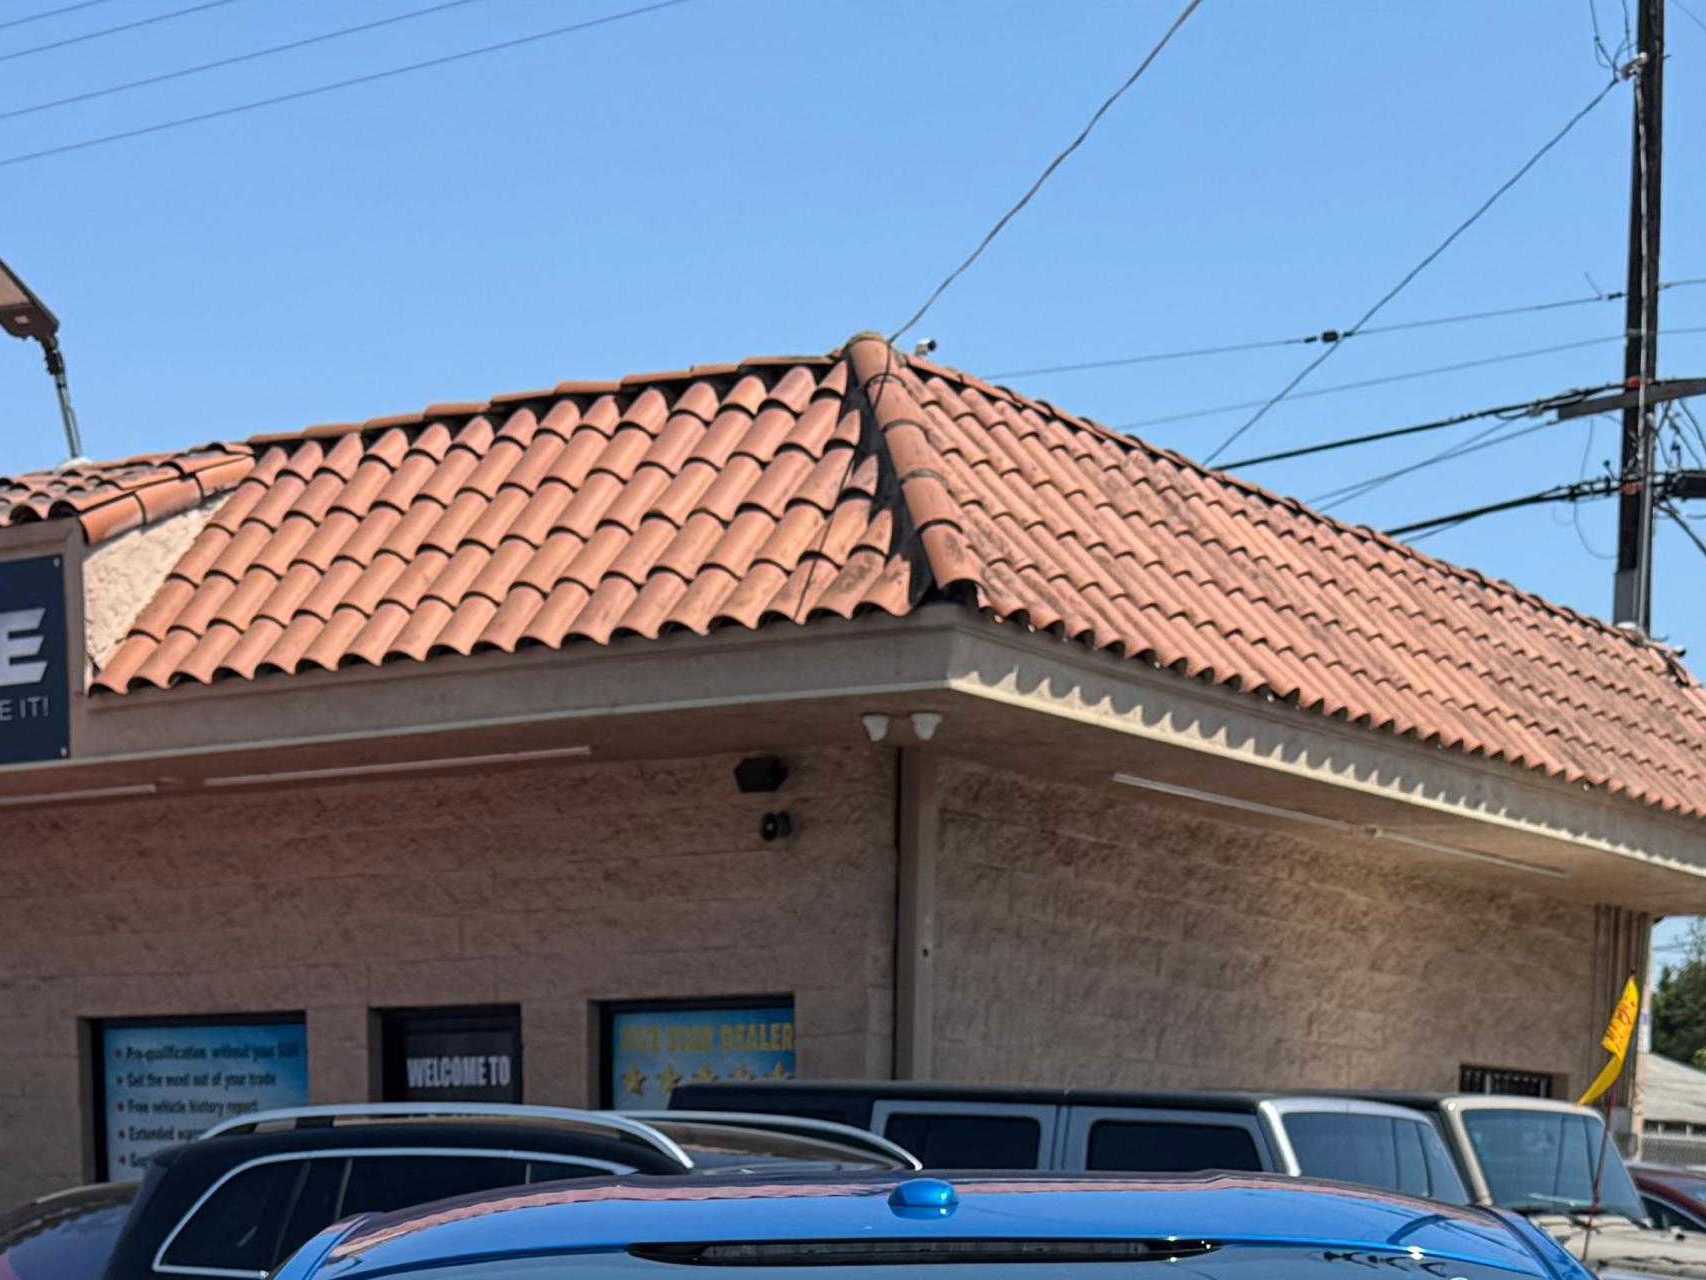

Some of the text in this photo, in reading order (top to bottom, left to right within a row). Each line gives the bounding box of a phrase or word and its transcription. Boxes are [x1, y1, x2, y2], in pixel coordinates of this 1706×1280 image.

[18, 696, 49, 719] IT!
[407, 1055, 511, 1088] WELCOME TO
